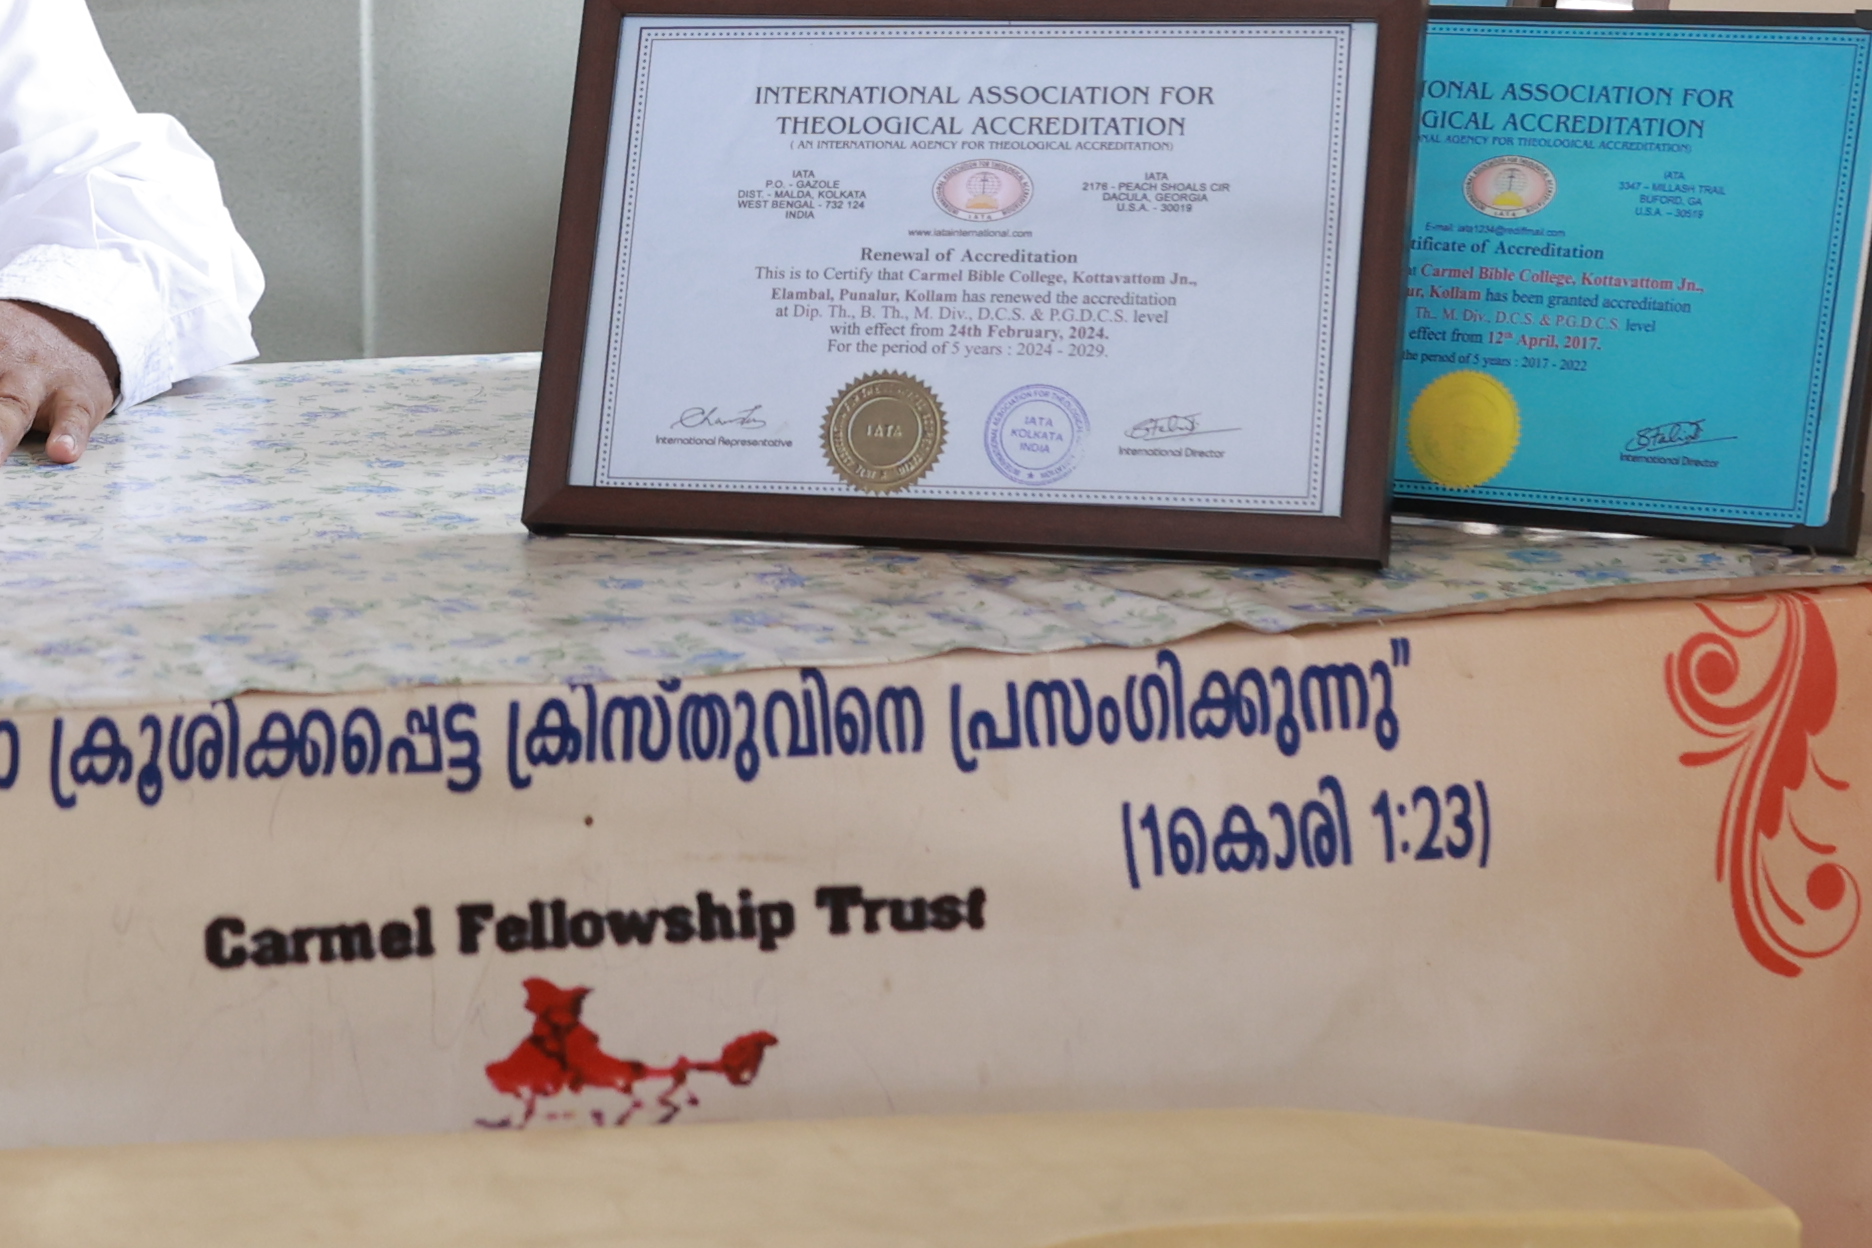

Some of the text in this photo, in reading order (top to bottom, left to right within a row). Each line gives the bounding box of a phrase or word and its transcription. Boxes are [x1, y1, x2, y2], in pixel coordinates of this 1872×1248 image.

[754, 85, 1214, 104] INTERNATIONAL ASSOCIATION FOR
[1500, 82, 1734, 108] ASSOCIATION FOR
[776, 115, 1185, 135] THEOLOGICAL ACCREDITATION
[1502, 112, 1704, 138] ACCREDITATION
[797, 139, 1173, 151] AN INTERNATIONAL AGENCY FOR THEOLOGICAL ACCREDITATION)
[792, 169, 815, 179] IATA
[1144, 171, 1169, 182] IATA
[765, 179, 840, 190] P.O. GAZOLE
[737, 190, 866, 200] DIST. MALDA, KOLKATA
[737, 199, 865, 209] WEST BENGAL 732 124
[1102, 191, 1208, 204] DACULA, GEORGIA
[785, 210, 814, 219] INDIA
[1116, 202, 1192, 212] U.S.A. 30019
[860, 247, 1077, 263] Renewal of Accreditation
[1470, 239, 1604, 259] of Accreditation
[754, 265, 1197, 286] This is to Certify that Carmel Bible College, Kottavattom Jn.,
[1421, 263, 1704, 293] Carmel Bible College, Kottavattom Jn.,
[770, 287, 1176, 306] Elambal, Punalur, Kollam has renewed the accreditation
[1429, 285, 1691, 313] Kollam has been granted accreditation
[775, 303, 1168, 323] at Dip. Th., B. Th., M. Div., D.C.S. & P.G.D.C.S. level
[829, 321, 1109, 342] with effect from 24th February, 2024.
[1408, 326, 1601, 350] effect from April, 2017.
[827, 338, 1108, 358] For the period of 5 years 2024 2029.
[1025, 415, 1053, 428] IATA
[655, 434, 792, 447] International Representative
[1010, 428, 1064, 442] KOLKATA
[1019, 441, 1051, 453] INDIA
[50, 699, 482, 808] ക്രൂശിക്കപ്പെട്ട
[508, 667, 924, 788] ക്രിസ്തുവിനെ
[1371, 781, 1492, 869] 1:23)
[204, 886, 986, 969] Carmel Fellowship Trust
